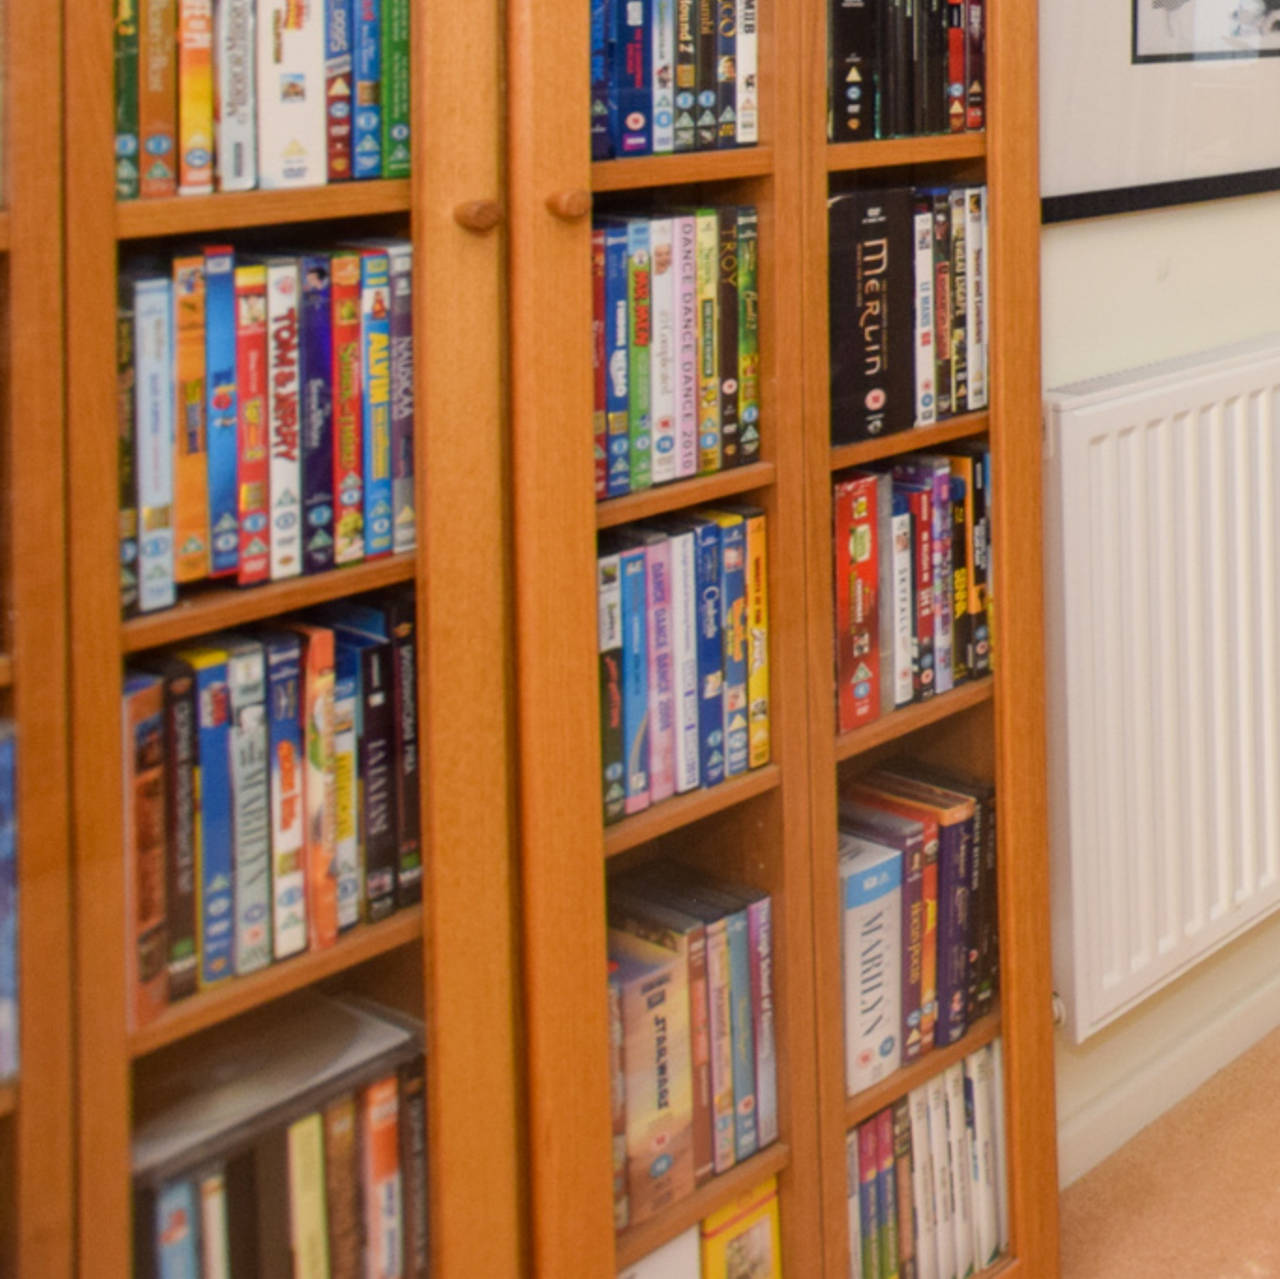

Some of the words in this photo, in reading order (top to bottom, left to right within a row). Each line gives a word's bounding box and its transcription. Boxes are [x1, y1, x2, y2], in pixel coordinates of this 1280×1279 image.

[681, 223, 695, 284] DANCE
[721, 224, 738, 288] TROY
[272, 307, 299, 368] TOM
[681, 291, 695, 354] DANCE
[922, 295, 932, 328] MANS
[368, 332, 391, 405] ALVIN
[681, 360, 695, 423] DANCE
[861, 910, 884, 1037] MARILYN
